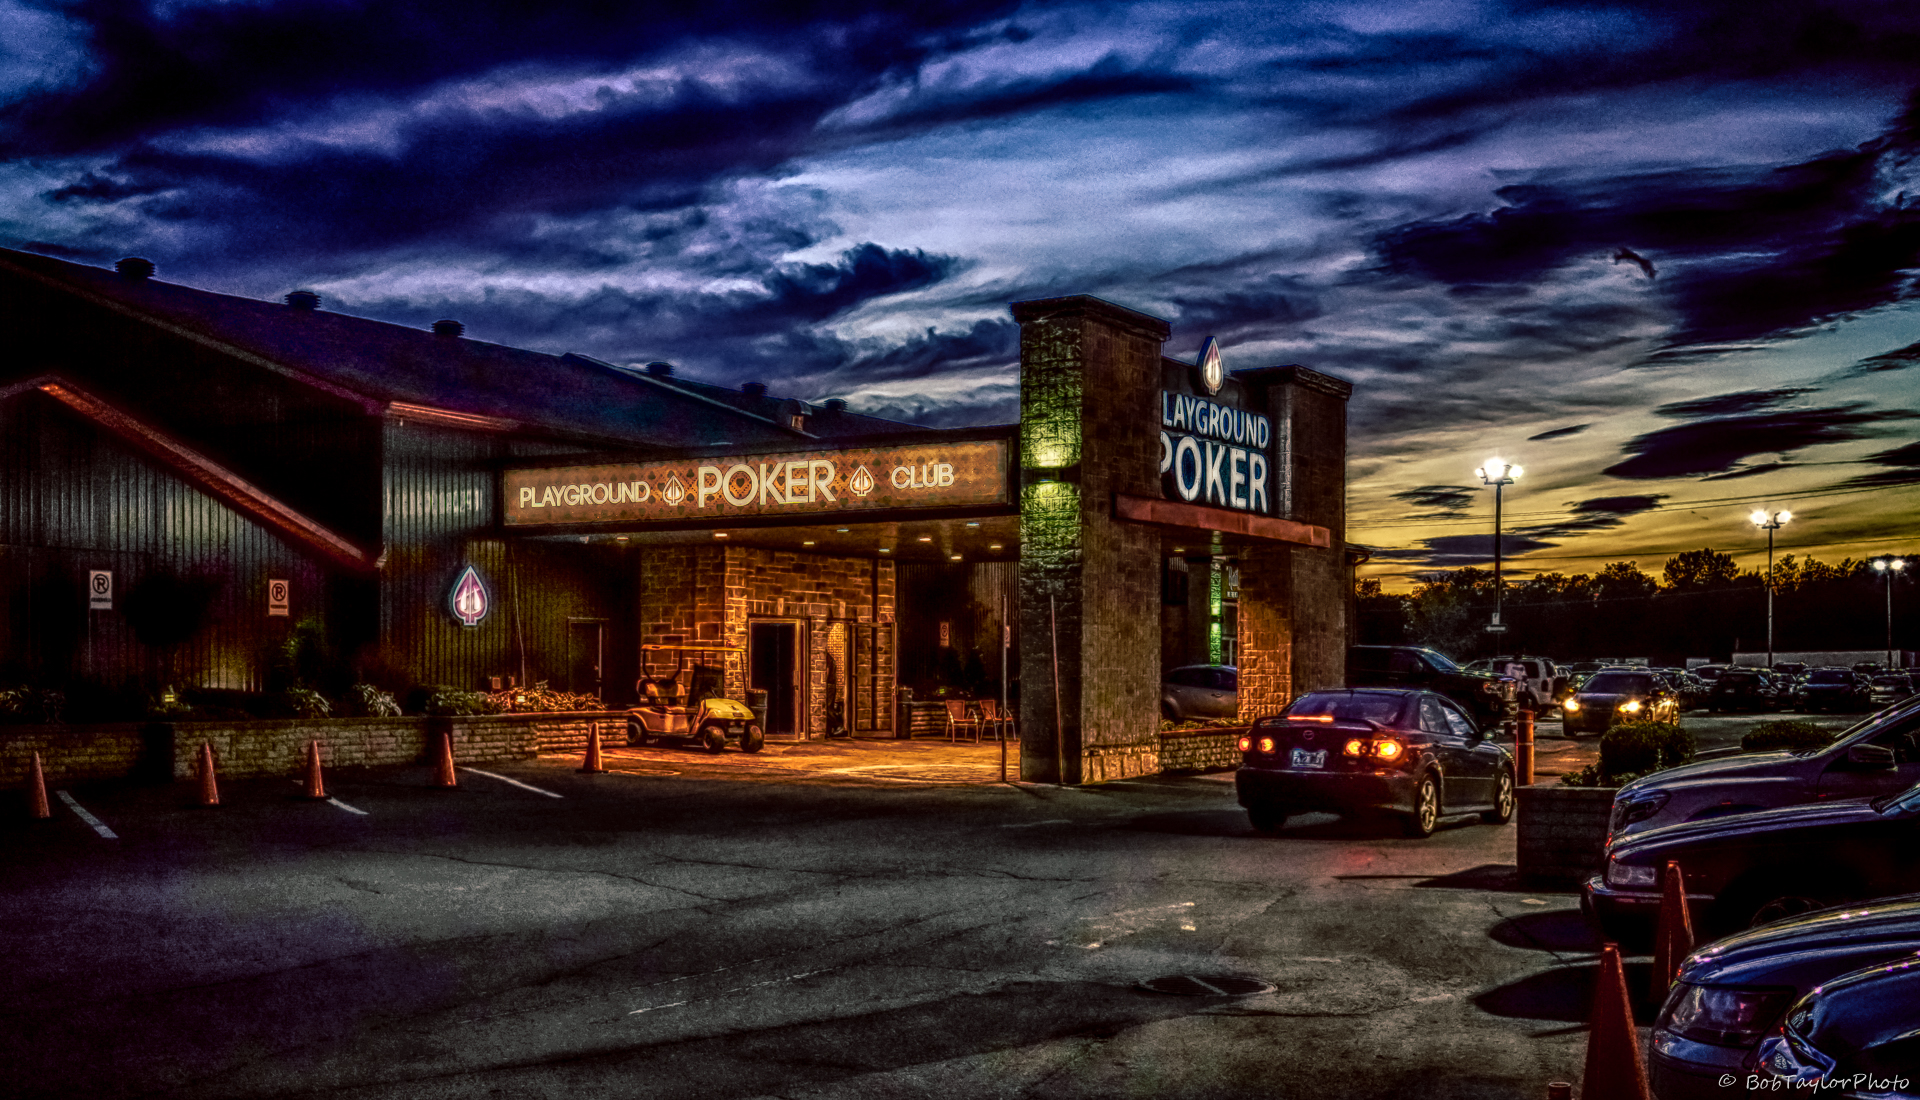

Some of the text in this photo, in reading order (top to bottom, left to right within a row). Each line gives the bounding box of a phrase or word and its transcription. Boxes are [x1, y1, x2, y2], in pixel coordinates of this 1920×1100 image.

[1162, 389, 1270, 450] LAYGROUND
[519, 459, 955, 509] PLAYGROUND POKER CLUB
